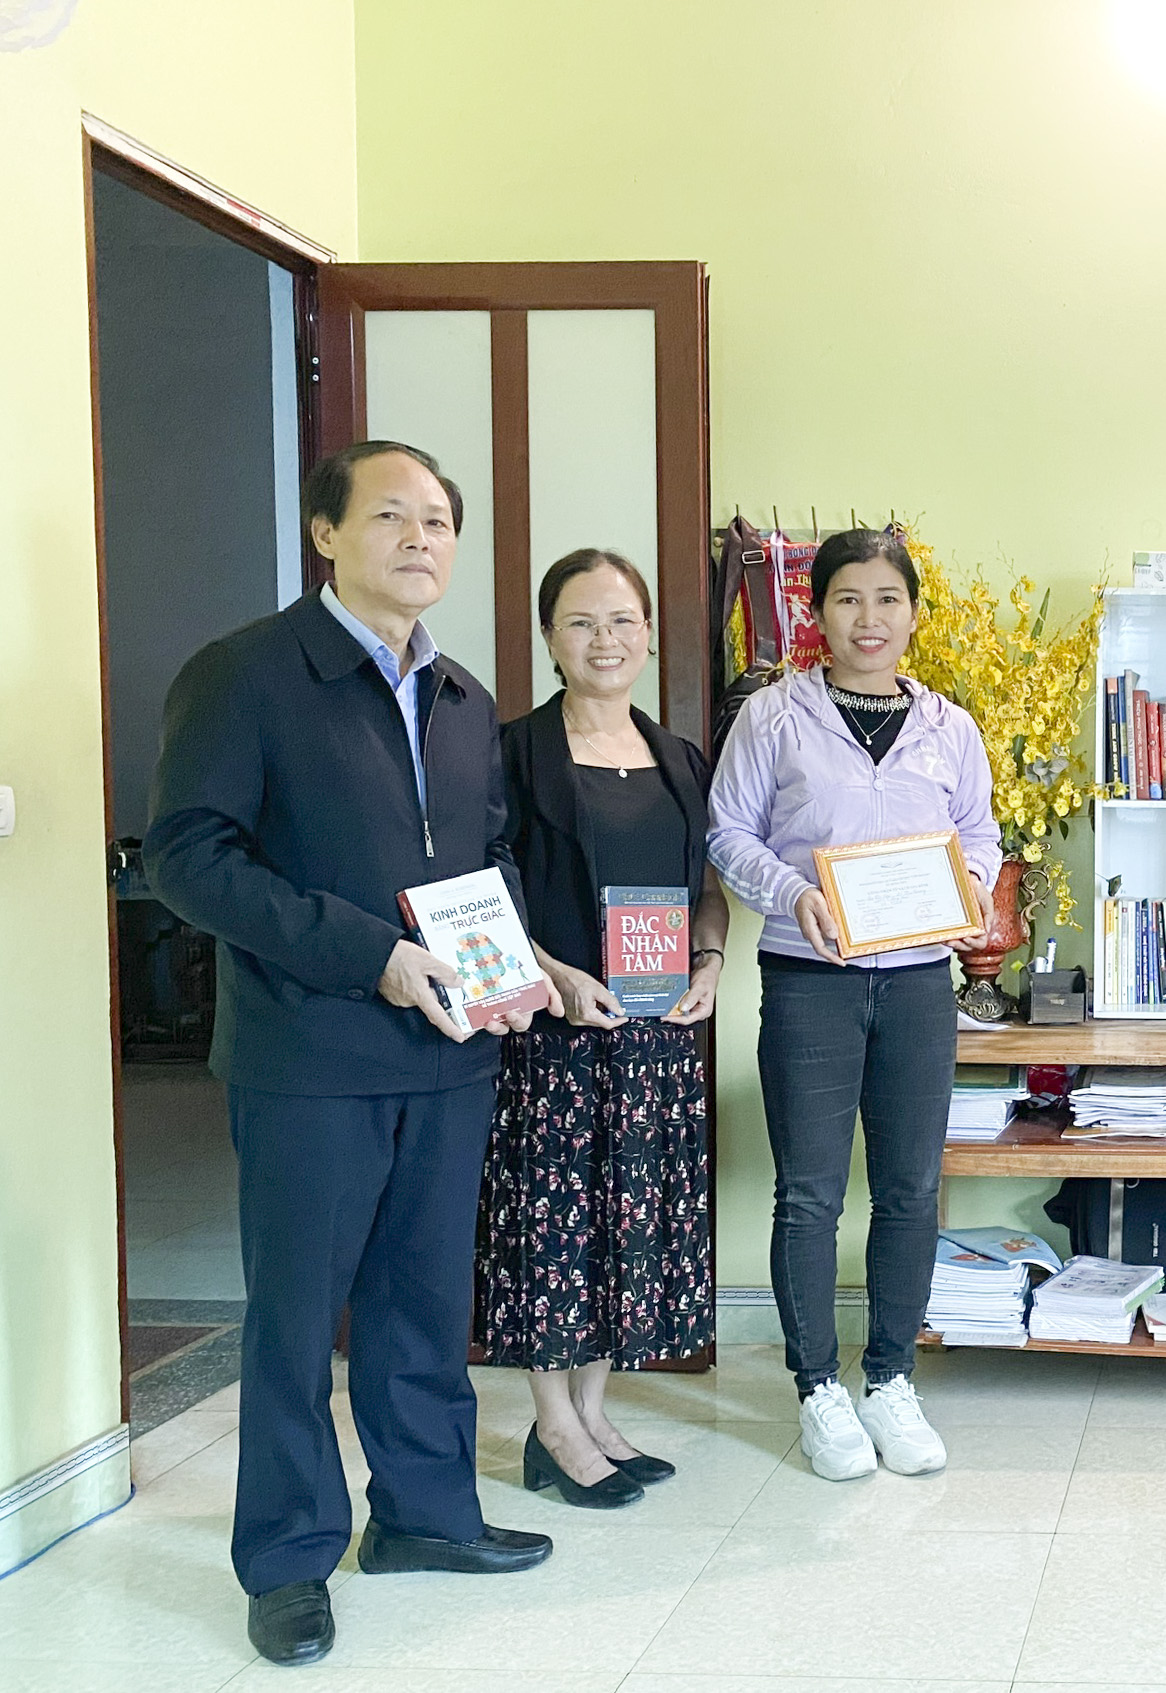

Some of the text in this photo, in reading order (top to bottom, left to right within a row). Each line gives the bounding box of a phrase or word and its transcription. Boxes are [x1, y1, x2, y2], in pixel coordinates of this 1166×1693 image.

[429, 907, 458, 923] KINH
[459, 895, 502, 915] DOANH
[449, 914, 480, 931] TRỰC
[480, 907, 506, 922] GIÁC
[621, 933, 678, 953] NHÂN
[621, 952, 664, 972] TÂM
